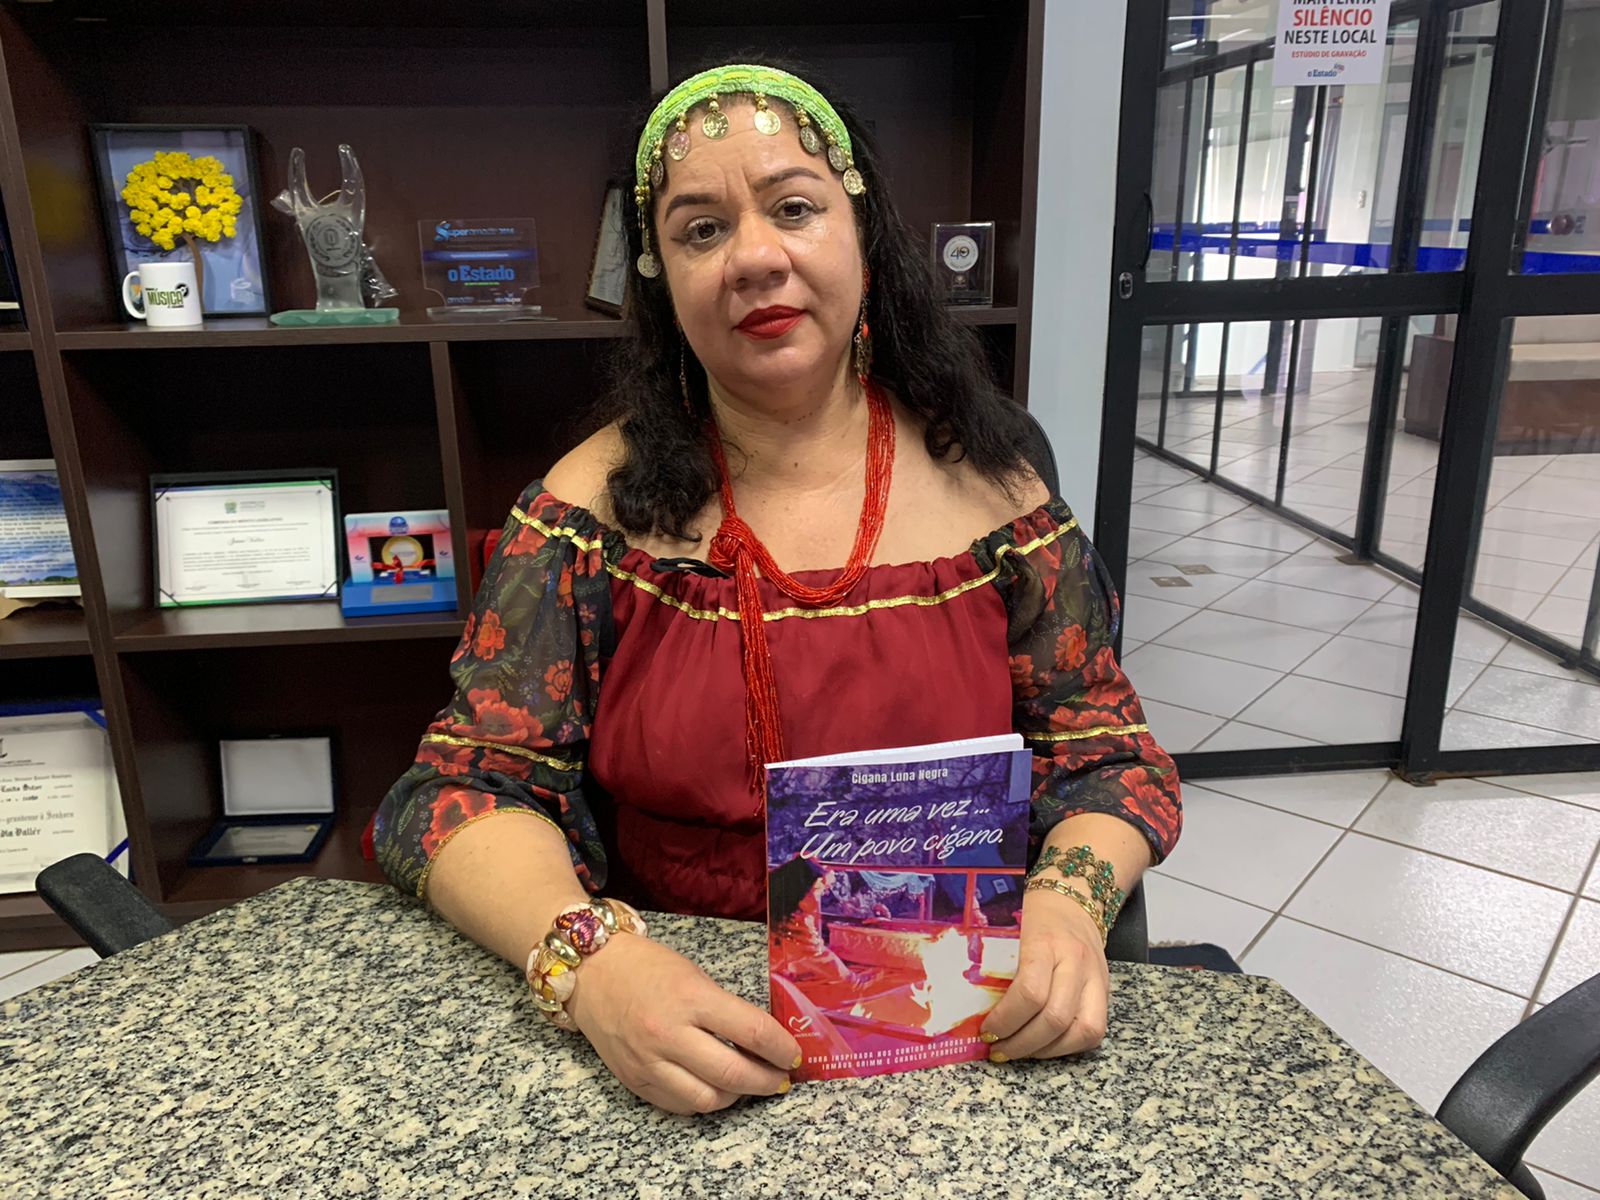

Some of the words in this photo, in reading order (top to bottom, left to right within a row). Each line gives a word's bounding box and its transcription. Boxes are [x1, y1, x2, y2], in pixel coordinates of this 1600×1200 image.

[1293, 6, 1373, 26] SILÊNCIO
[1284, 30, 1329, 44] NESTE
[1332, 29, 1377, 44] LOCAL
[1321, 50, 1330, 58] DE
[1331, 49, 1367, 59] GRAVAÇÃO
[1312, 68, 1337, 77] Estado
[459, 264, 515, 281] Estado
[852, 772, 887, 785] Cigana
[890, 770, 915, 783] Luna
[918, 767, 948, 780] Negra
[803, 801, 857, 828] Era
[864, 804, 922, 825] uma
[800, 834, 851, 859] Um
[849, 837, 917, 864] povo
[923, 825, 1004, 860] cigano.
